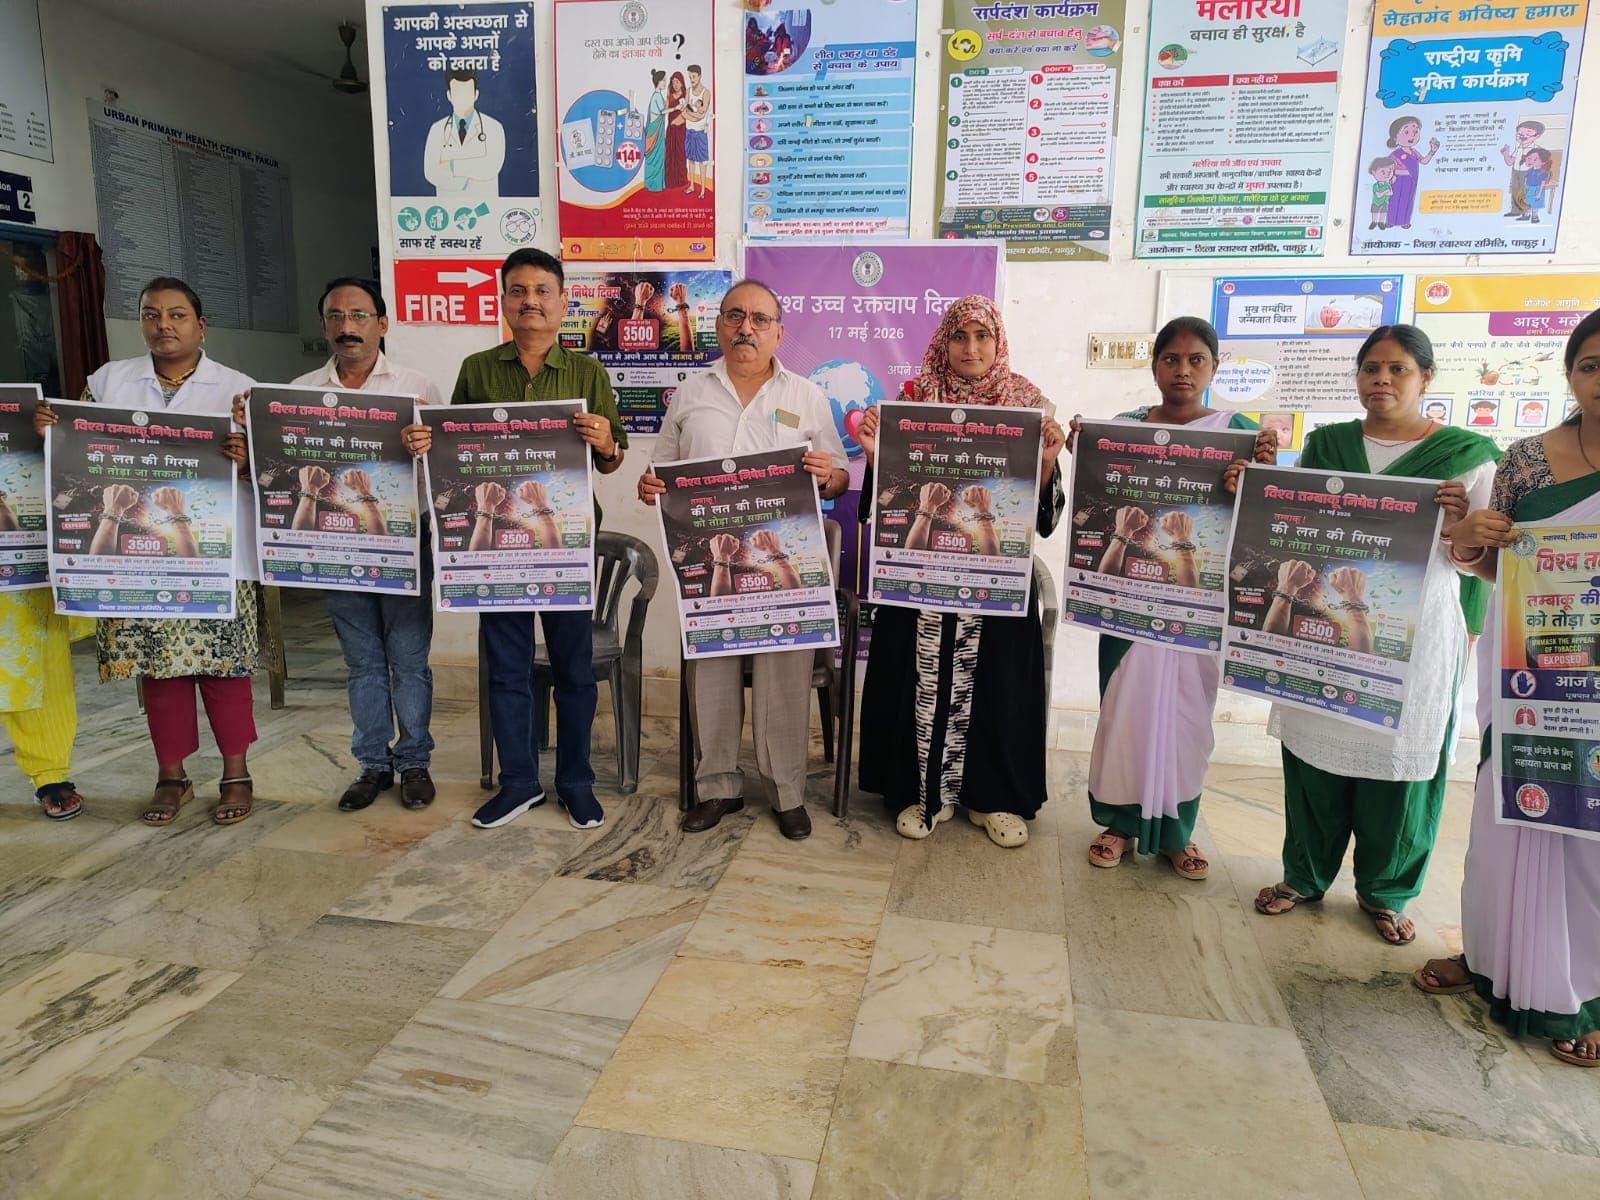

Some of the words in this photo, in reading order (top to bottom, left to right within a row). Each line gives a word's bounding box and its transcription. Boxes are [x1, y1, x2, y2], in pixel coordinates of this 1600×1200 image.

[973, 1, 1029, 20] सर्पदंश
[1034, 0, 1099, 18] कार्यक्रम
[1383, 7, 1452, 27] सेहतमंद
[1459, 4, 1519, 22] भविष्य
[1526, 4, 1579, 19] हमारा
[393, 12, 439, 31] आपकी
[444, 14, 508, 30] अस्वच्छता
[514, 10, 528, 28] से
[1028, 29, 1036, 39] से
[1040, 30, 1063, 38] बचाव
[1067, 27, 1083, 40] हेतु
[1190, 28, 1228, 41] बचाव
[1233, 25, 1248, 39] ही
[1295, 22, 1305, 38] है
[416, 32, 456, 51] आपके
[461, 31, 500, 49] अपनों
[603, 39, 613, 47] का
[673, 33, 685, 60] ?
[428, 53, 447, 71] को
[449, 56, 488, 70] खतरा
[490, 50, 501, 71] है
[814, 49, 834, 59] शीत
[839, 51, 861, 59] लहर
[882, 47, 897, 57] ठंड
[1424, 46, 1480, 68] राष्ट्रीय
[1485, 43, 1523, 67] कृमि
[813, 61, 822, 70] से
[858, 60, 867, 68] के
[874, 60, 898, 68] उपाय
[1462, 69, 1529, 88] कार्यक्रम
[103, 107, 140, 126] URBAN
[142, 120, 182, 138] PRIMARY
[185, 133, 218, 150] HEALTH
[255, 154, 279, 168] PAKUR
[622, 150, 634, 162] 14
[1166, 183, 1177, 191] और
[22, 193, 31, 209] 2
[399, 238, 422, 248] साफ
[424, 235, 437, 249] रहें
[440, 238, 468, 248] स्वस्थ
[470, 236, 483, 249] रहें
[1413, 238, 1436, 248] जिला
[1439, 240, 1472, 248] स्वास्थ्य
[571, 287, 595, 298] निषेध
[405, 294, 466, 322] FIRE
[811, 294, 846, 315] उच्च
[853, 294, 917, 315] रक्तचाप
[1245, 305, 1258, 316] मुख
[1238, 316, 1271, 324] जन्मजात
[1273, 314, 1296, 324] विकार
[1513, 316, 1551, 329] आइए
[624, 326, 653, 341] 3500
[829, 327, 842, 340] 17
[848, 321, 869, 342] मई
[874, 327, 905, 340] 2026
[282, 433, 297, 445] की
[304, 437, 323, 447] लत
[330, 436, 345, 448] की
[351, 437, 383, 451] गिरफ्त
[87, 452, 104, 463] की
[112, 454, 134, 465] लत
[141, 454, 157, 467] की
[165, 455, 199, 468] गिरफ्त
[457, 450, 472, 462] की
[479, 452, 498, 462] लत
[505, 449, 519, 461] की
[525, 449, 556, 460] गिरफ्त
[908, 450, 923, 463] की
[930, 453, 948, 463] लत
[955, 452, 969, 464] की
[975, 453, 1006, 466] गिरफ्त
[1105, 471, 1121, 484] की
[1128, 475, 1147, 486] लत
[1156, 476, 1171, 488] की
[1178, 478, 1213, 493] गिरफ्त
[691, 505, 705, 516] की
[712, 504, 730, 514] लत
[736, 501, 750, 512] की
[755, 497, 785, 509] गिरफ्त
[325, 516, 353, 528] 3500
[501, 533, 529, 544] 3500
[937, 535, 966, 547] 3500
[1271, 522, 1288, 535] की
[1296, 526, 1317, 539] लत
[1326, 527, 1344, 542] की
[1352, 530, 1392, 547] गिरफ्त
[128, 539, 160, 551] 3500
[1536, 548, 1580, 572] विश्व
[1131, 562, 1162, 577] 3500
[740, 576, 768, 588] 3500
[1527, 594, 1575, 610] तम्बाकू
[1580, 589, 1599, 606] की
[1526, 610, 1547, 627] को
[1552, 610, 1584, 630] तोड़ा
[1300, 620, 1334, 638] 3500
[1544, 654, 1581, 665] EXPOSED
[1556, 676, 1587, 688] आज
